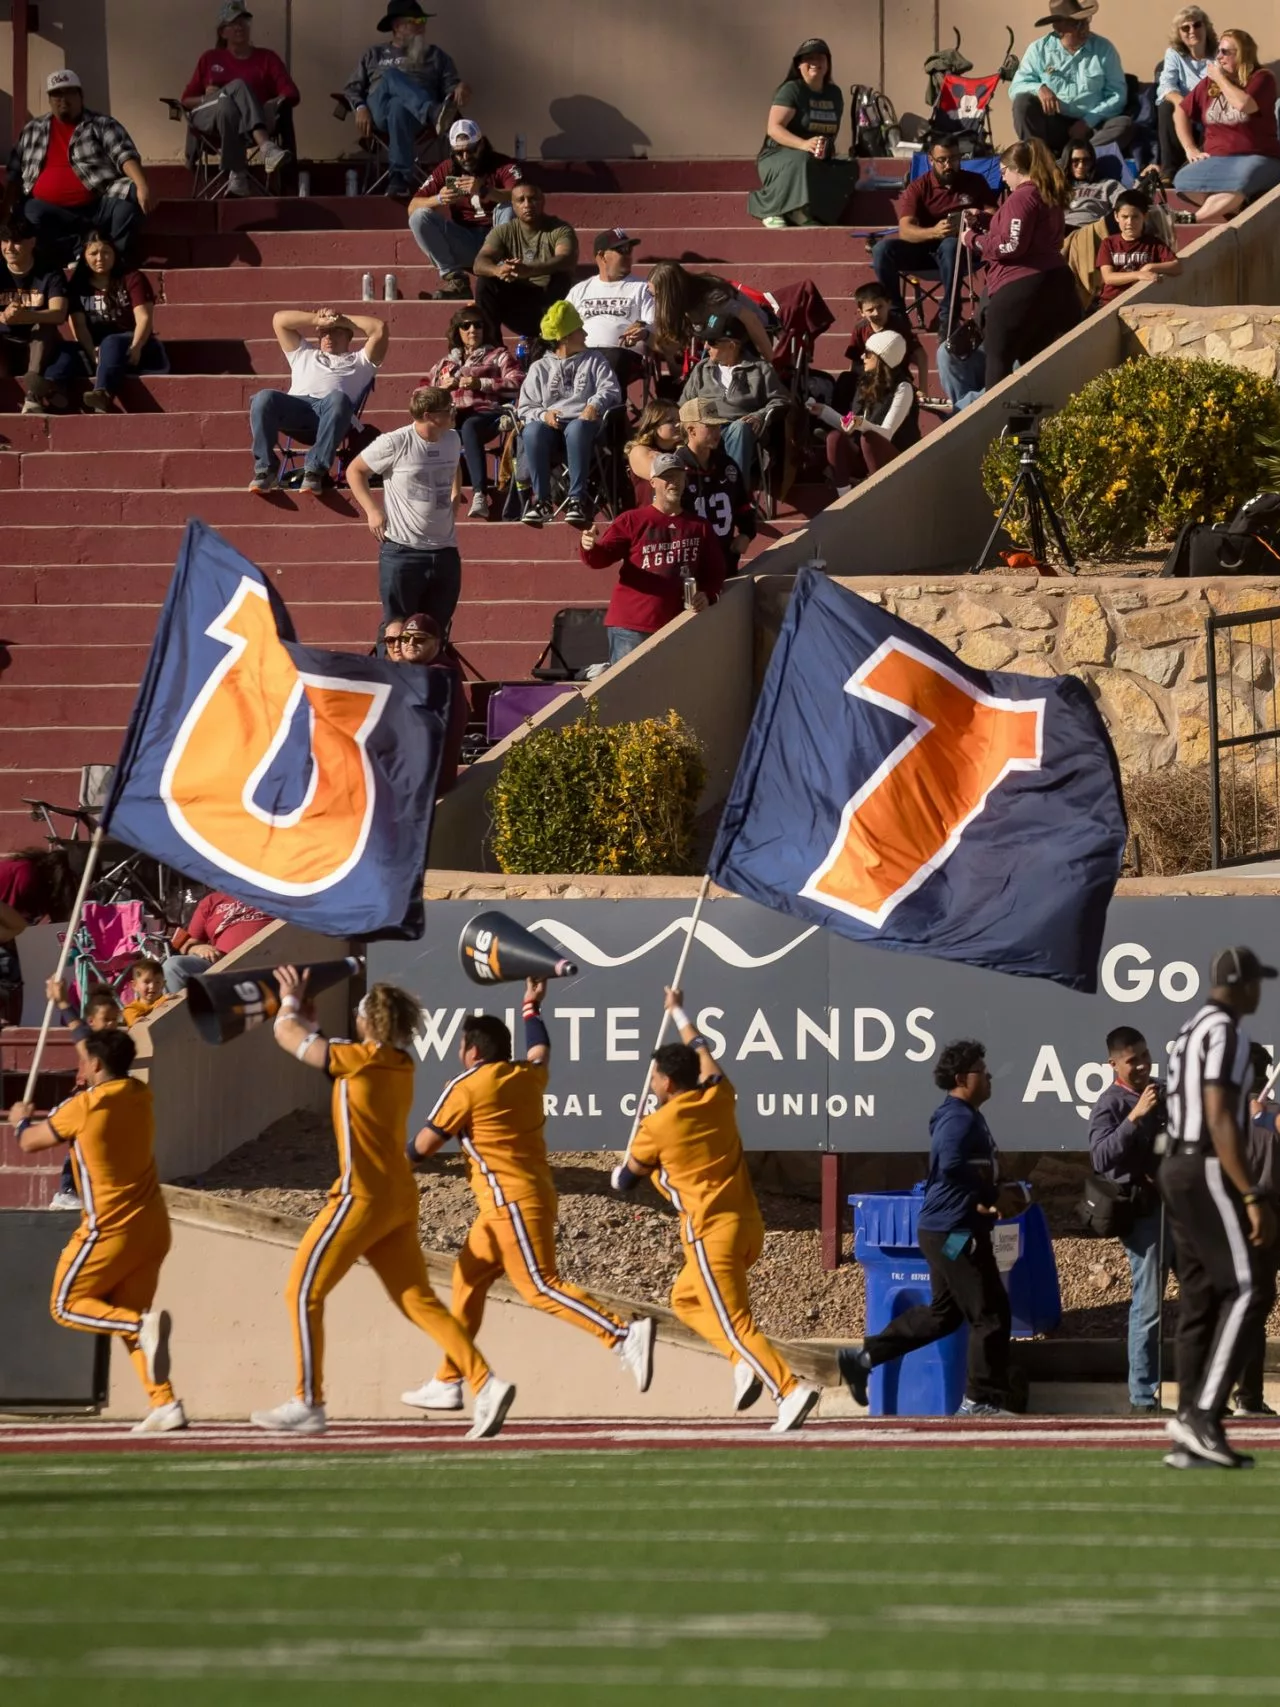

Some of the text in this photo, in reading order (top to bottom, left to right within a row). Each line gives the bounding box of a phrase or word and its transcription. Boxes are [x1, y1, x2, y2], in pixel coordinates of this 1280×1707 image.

[641, 547, 699, 569] AGGIES
[642, 537, 700, 555] NEW MEXICO STATE
[159, 575, 392, 897] U
[797, 635, 1046, 929] T
[1100, 942, 1201, 1004] Go
[695, 1005, 937, 1063] SANDS
[756, 1092, 876, 1118] UNION
